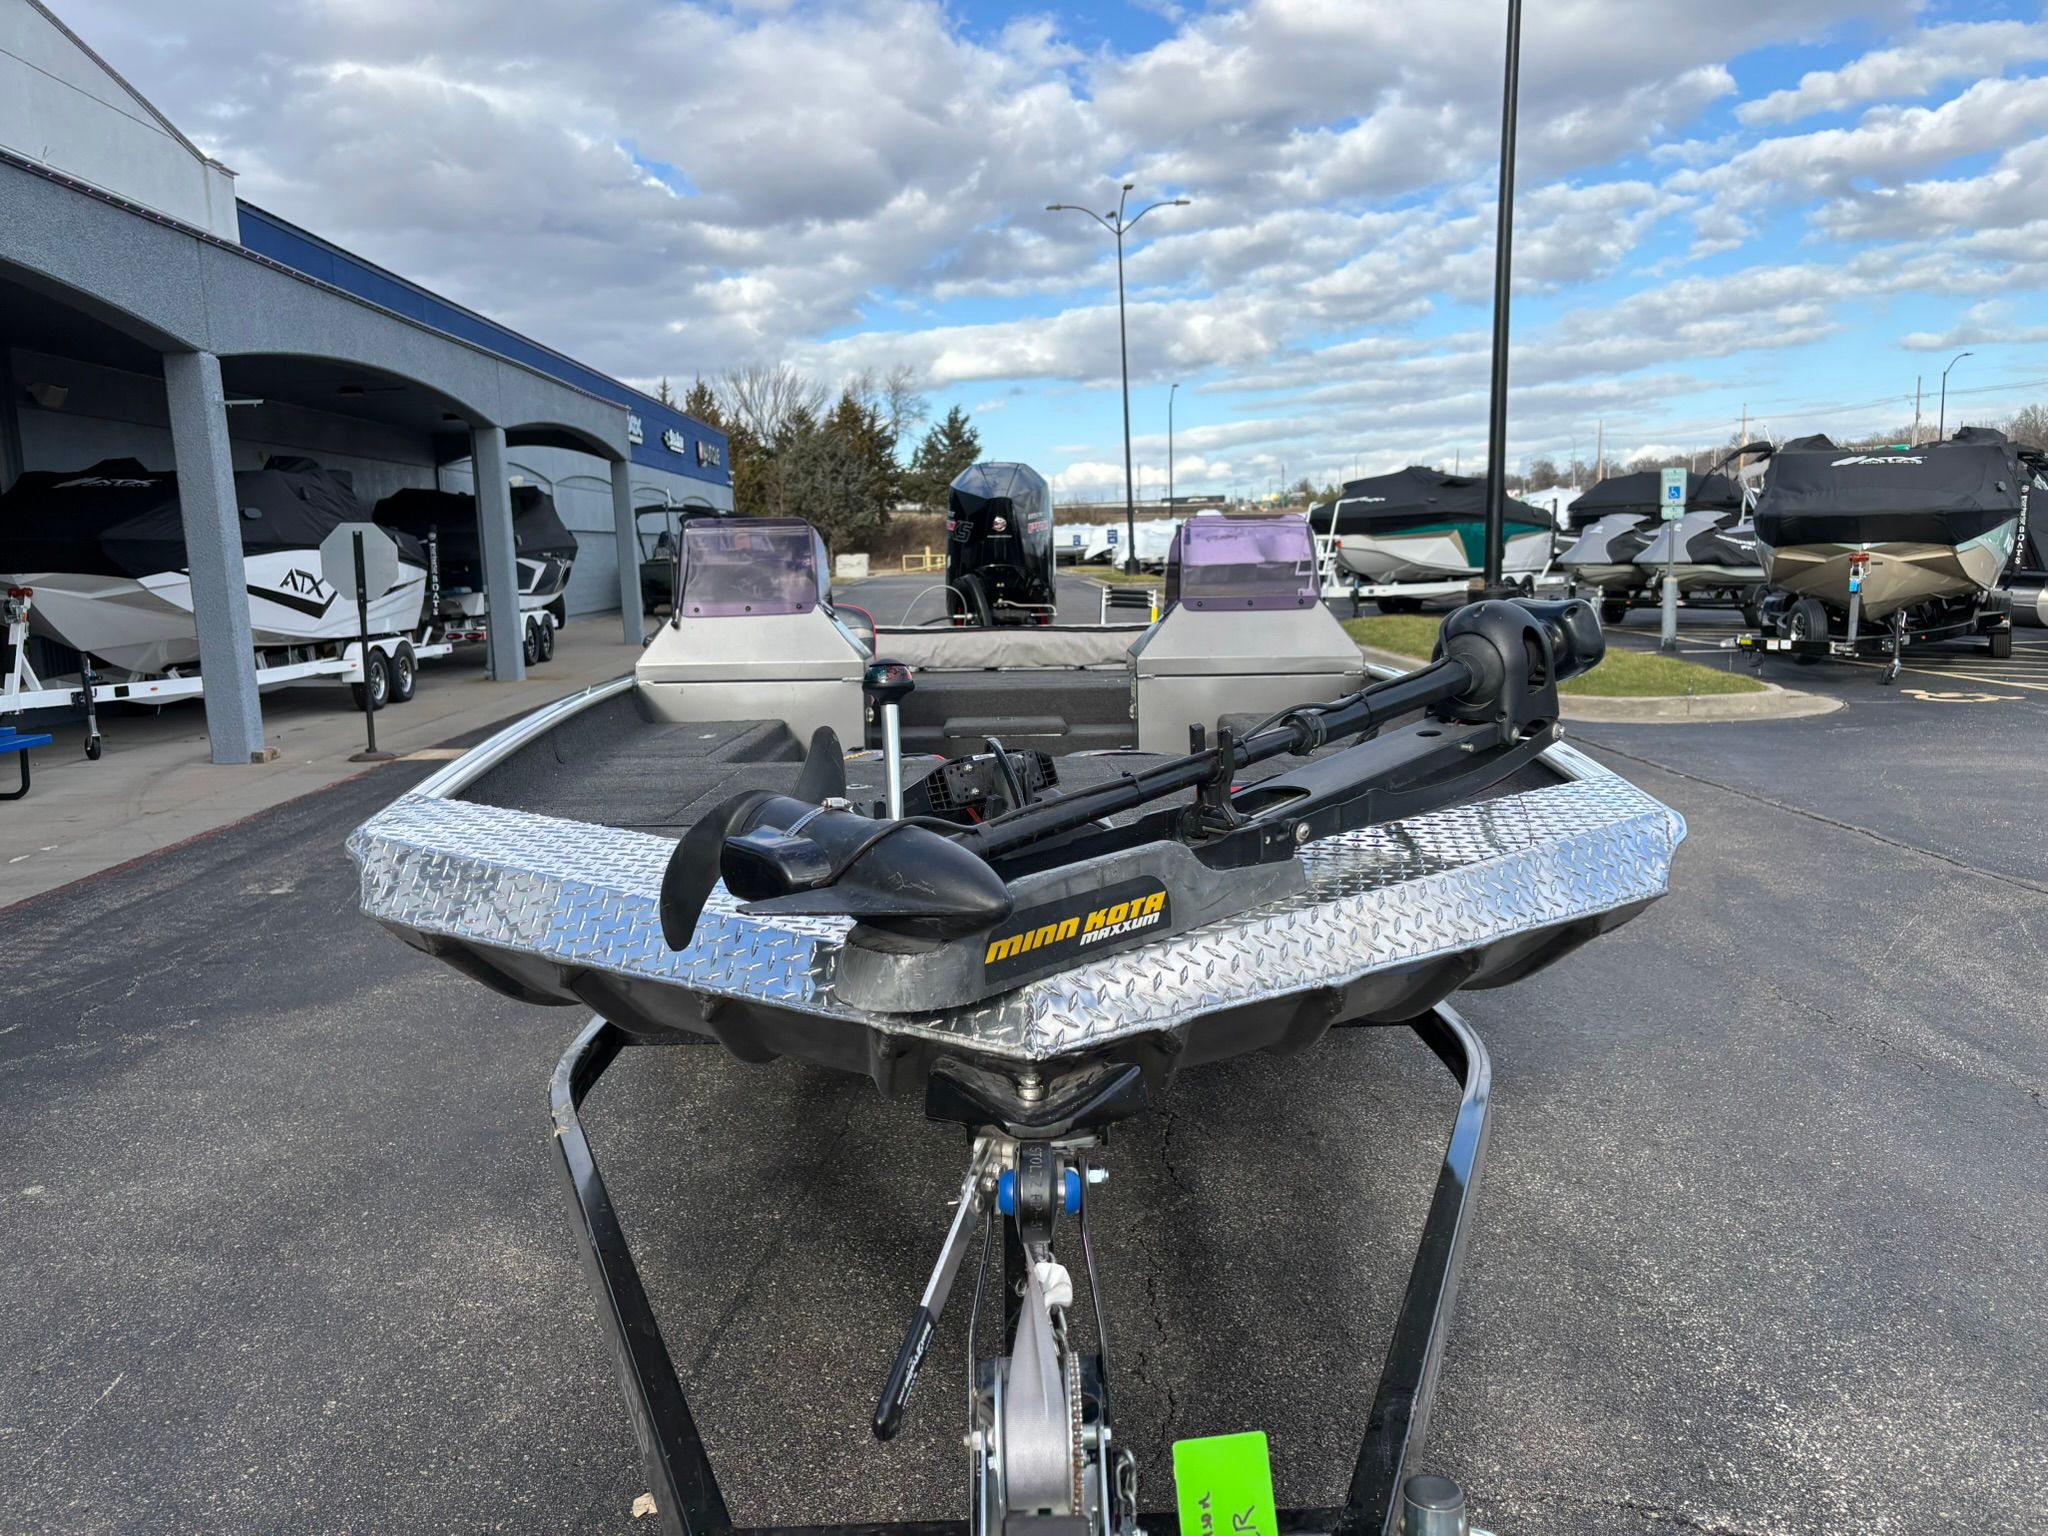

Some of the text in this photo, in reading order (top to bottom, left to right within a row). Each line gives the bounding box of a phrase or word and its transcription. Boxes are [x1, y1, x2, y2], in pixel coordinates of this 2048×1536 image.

[279, 567, 325, 600] ATX
[985, 891, 1166, 964] MINN KOTA
[1079, 911, 1160, 946] MAXXUM
